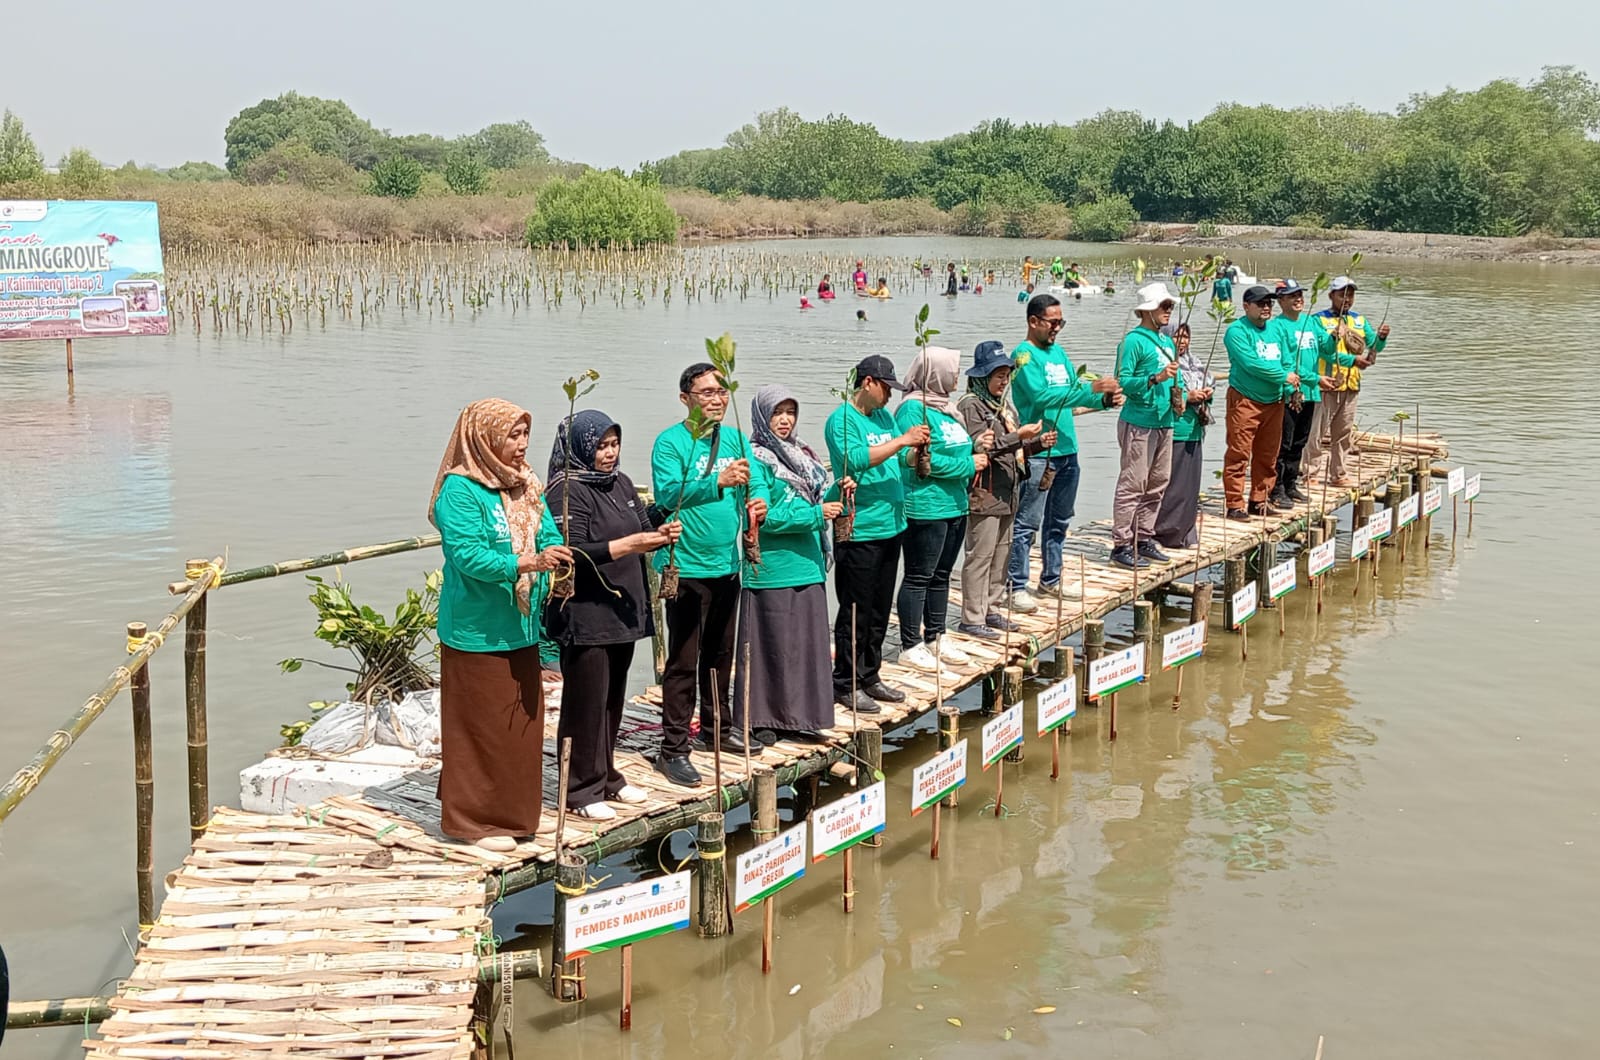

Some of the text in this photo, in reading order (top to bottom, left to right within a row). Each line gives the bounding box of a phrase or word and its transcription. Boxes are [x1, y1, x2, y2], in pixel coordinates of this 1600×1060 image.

[0, 245, 107, 269] MANGGROVE
[7, 276, 63, 293] Kalimireng
[65, 275, 94, 291] Tahap
[96, 275, 102, 289] 2
[825, 813, 854, 834] CABDIN
[860, 807, 866, 820] K
[867, 805, 873, 816] P
[840, 821, 861, 840] TUBAN
[743, 865, 764, 885] DINAS
[765, 845, 801, 873] PARIWISATA
[761, 866, 785, 887] GRESIK
[574, 899, 686, 938] PEMDES MANYAREJO
